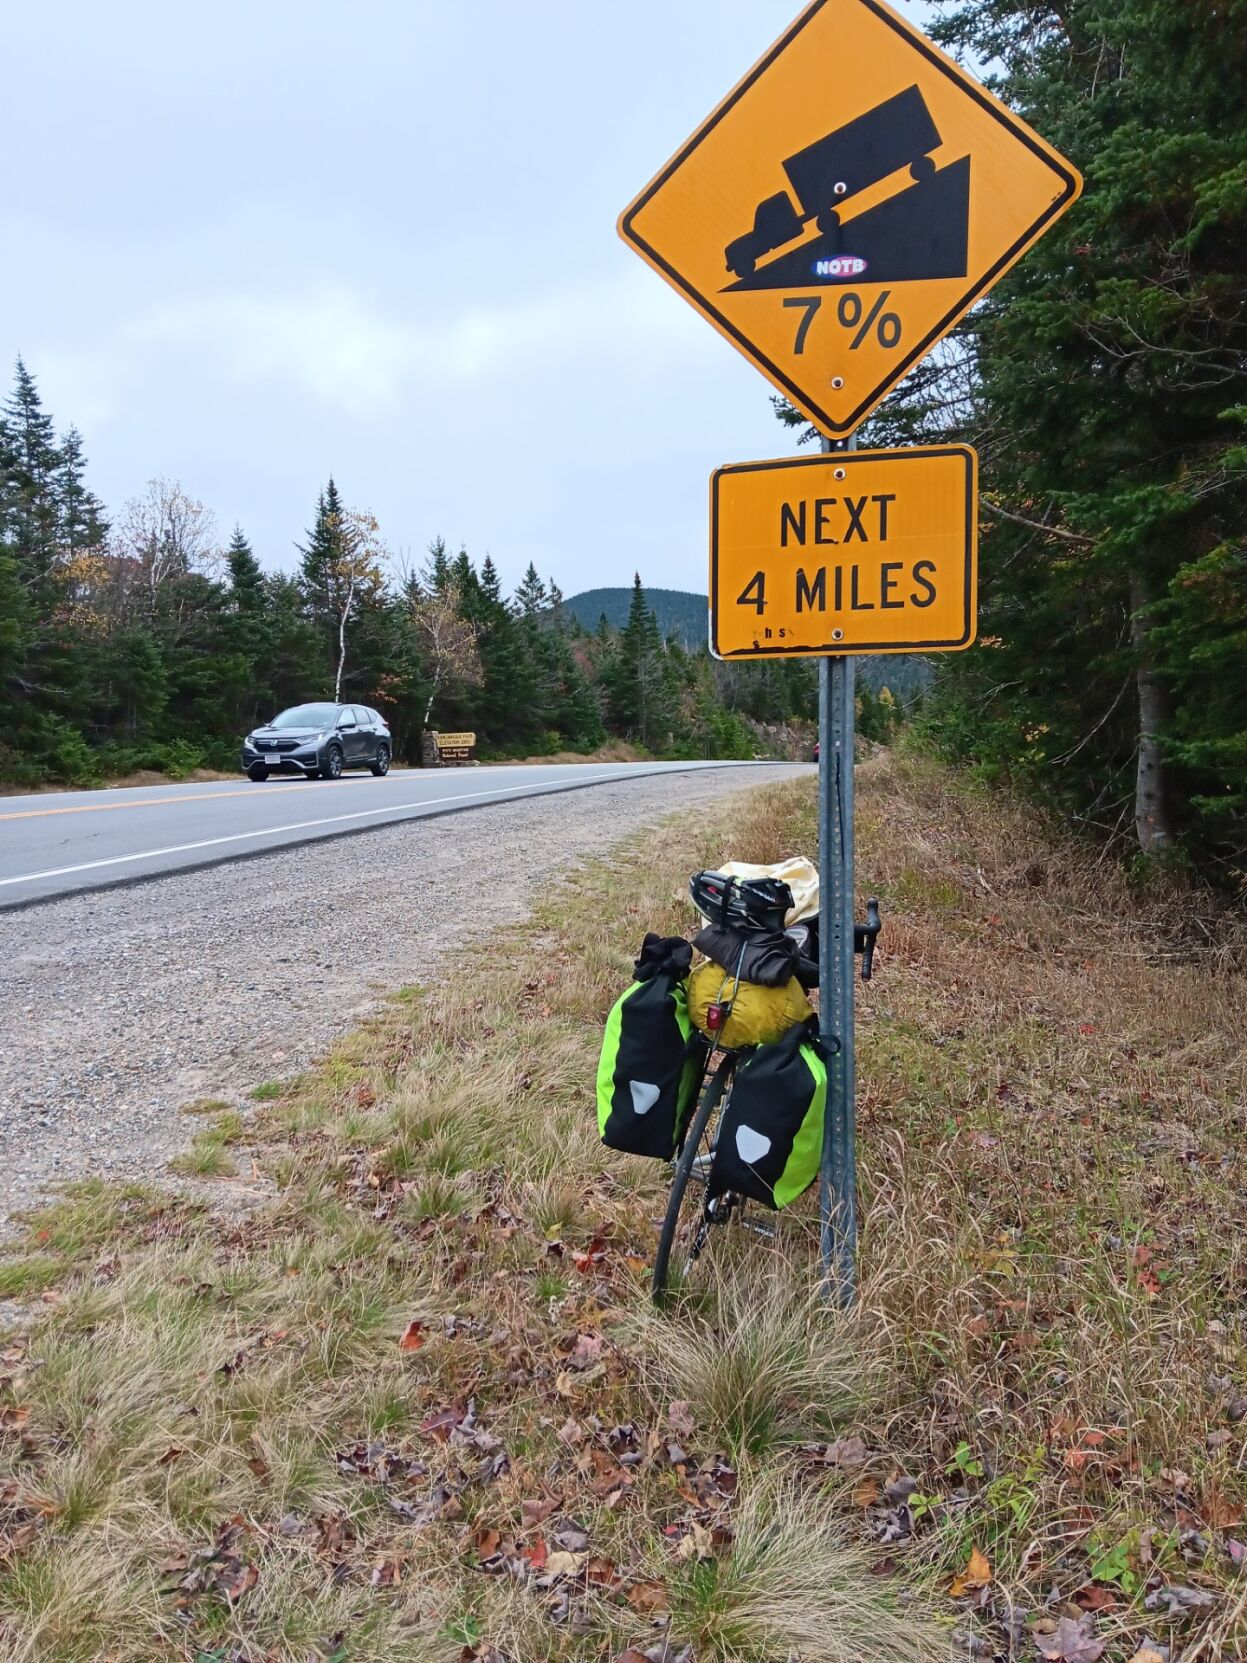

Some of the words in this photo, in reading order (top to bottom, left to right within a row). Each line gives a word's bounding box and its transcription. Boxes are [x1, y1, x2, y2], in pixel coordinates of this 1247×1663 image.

[816, 258, 865, 275] NOTB
[780, 493, 896, 547] NEXT
[736, 571, 768, 615] 4
[796, 560, 937, 613] MILES
